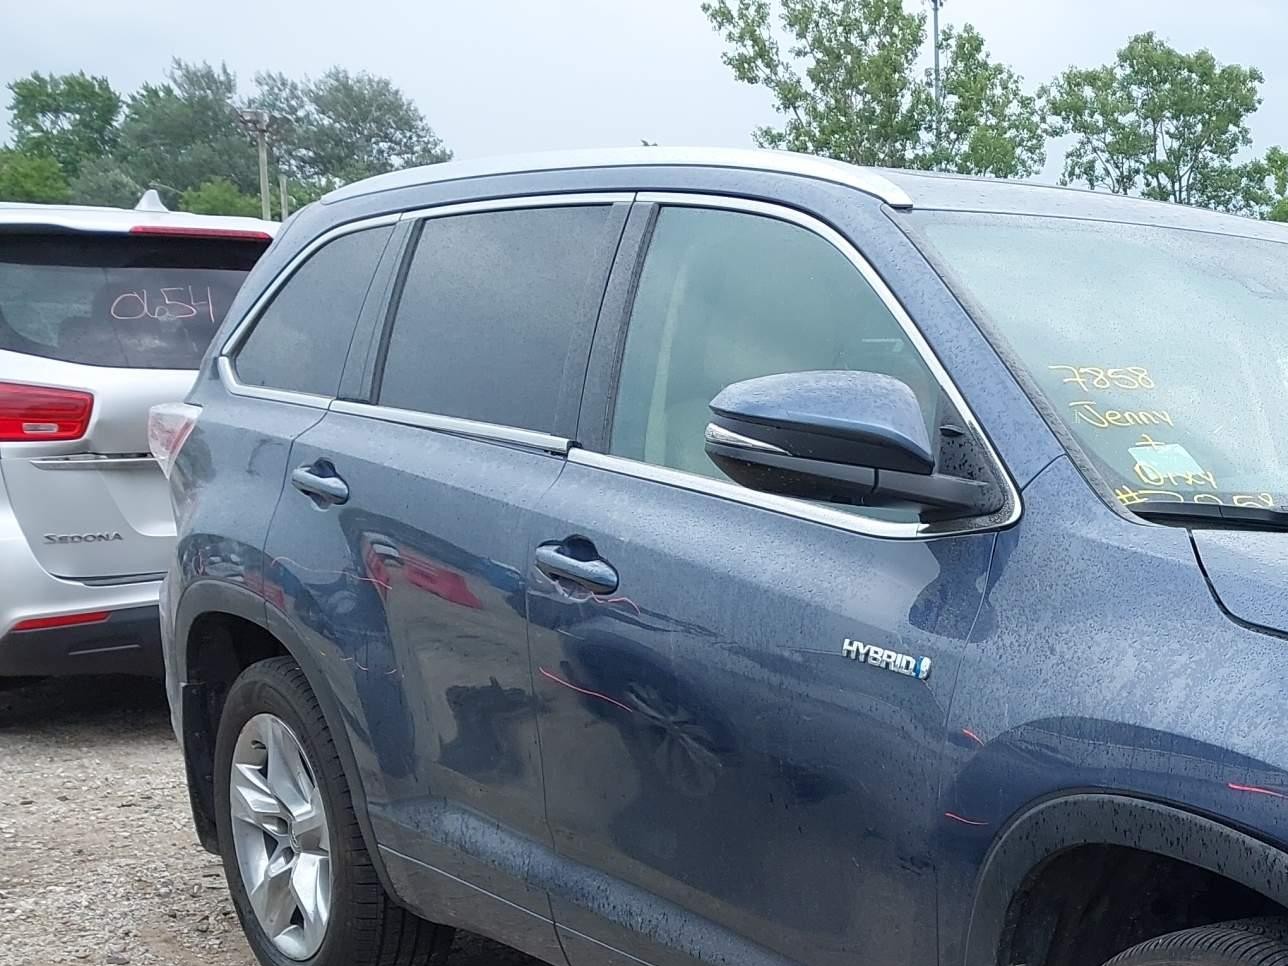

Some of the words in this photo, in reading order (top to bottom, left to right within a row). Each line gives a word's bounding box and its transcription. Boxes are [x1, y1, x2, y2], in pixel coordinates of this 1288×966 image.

[1047, 365, 1155, 392] 7858
[1068, 401, 1174, 428] Jenny
[43, 532, 123, 544] SEDONA
[841, 638, 917, 677] HYBRID
